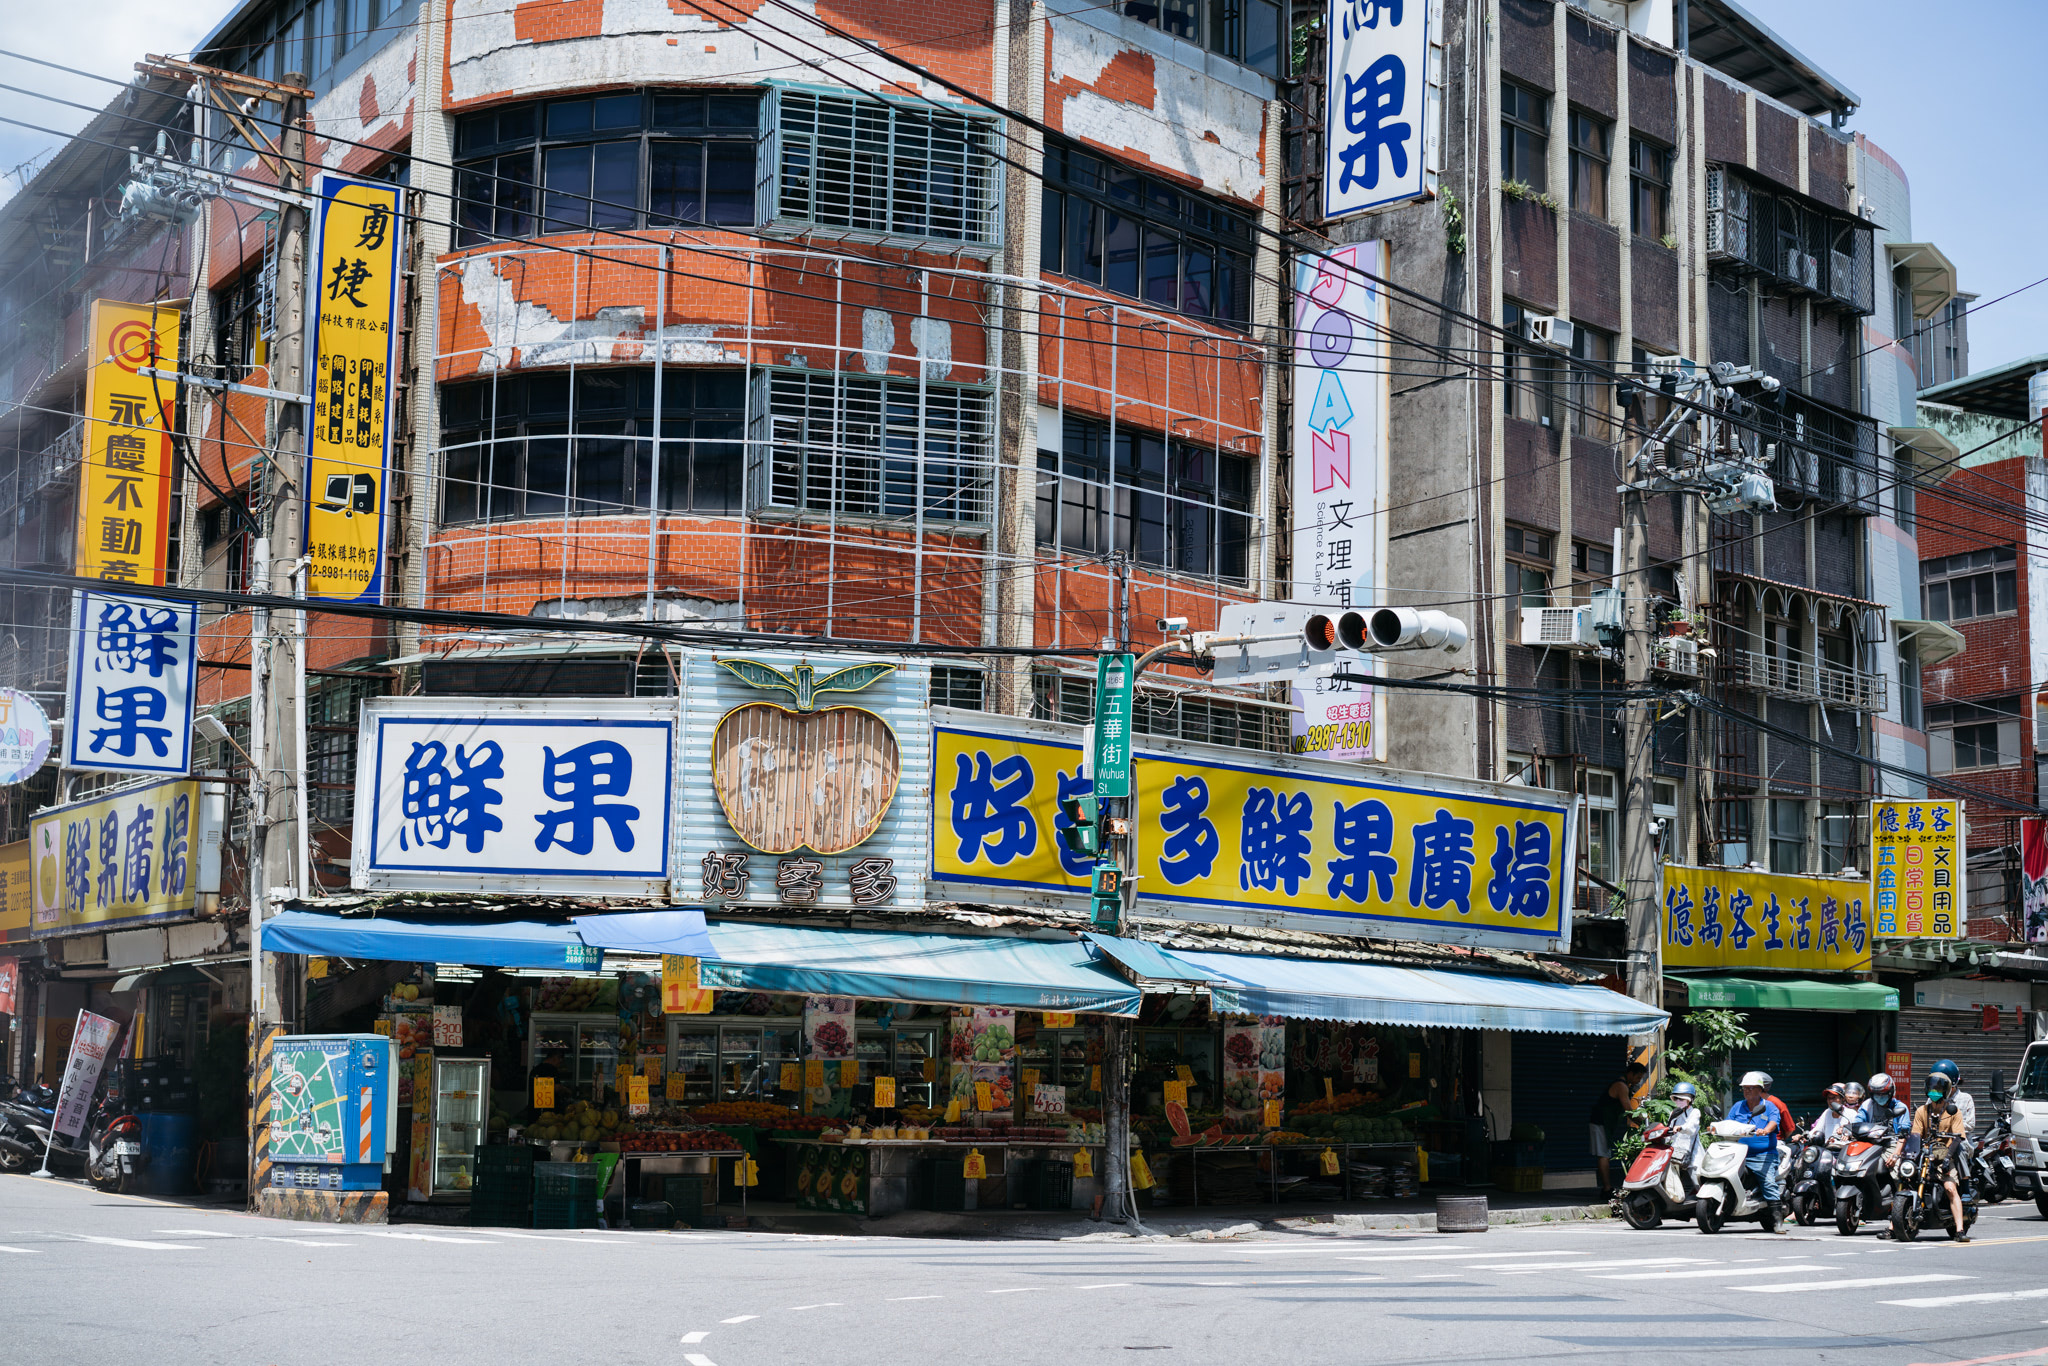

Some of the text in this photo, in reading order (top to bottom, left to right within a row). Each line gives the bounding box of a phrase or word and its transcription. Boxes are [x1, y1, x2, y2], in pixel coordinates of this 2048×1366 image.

[327, 203, 390, 308] 勇捷
[321, 313, 388, 334] 科技有限公司
[315, 354, 329, 442] 電腦維護
[331, 356, 345, 443] 網路建置
[345, 360, 357, 443] 3C產品
[358, 360, 372, 447] 印表耗材
[371, 362, 385, 448] 視聽系統
[1308, 247, 1354, 494] JOAN
[309, 541, 376, 566] 台銀採購契約商
[1316, 501, 1326, 548] Science
[308, 564, 370, 583] 02-8981-1168
[1327, 499, 1354, 693] 文理補班
[89, 602, 179, 758] 鮮果
[1327, 702, 1370, 720] 招生電話
[1102, 694, 1124, 766] 五華街
[399, 739, 641, 856] 鮮果
[1098, 767, 1125, 780] Wuhua
[1098, 782, 1110, 795] St.
[65, 791, 190, 914] 鮮果廣場
[1878, 805, 1953, 833] 億萬客
[702, 850, 898, 906] 好客多
[1103, 872, 1117, 893] 13
[1877, 845, 1897, 934] 五金用品
[1905, 845, 1924, 934] 日常百貨
[1932, 845, 1952, 934] 文具用品
[1665, 883, 1867, 956] 億萬客生活廣場
[666, 983, 707, 1011] 17
[704, 977, 741, 986] 2895080
[442, 1023, 462, 1034] 300
[443, 1034, 463, 1046] 160
[536, 1091, 553, 1107] 85
